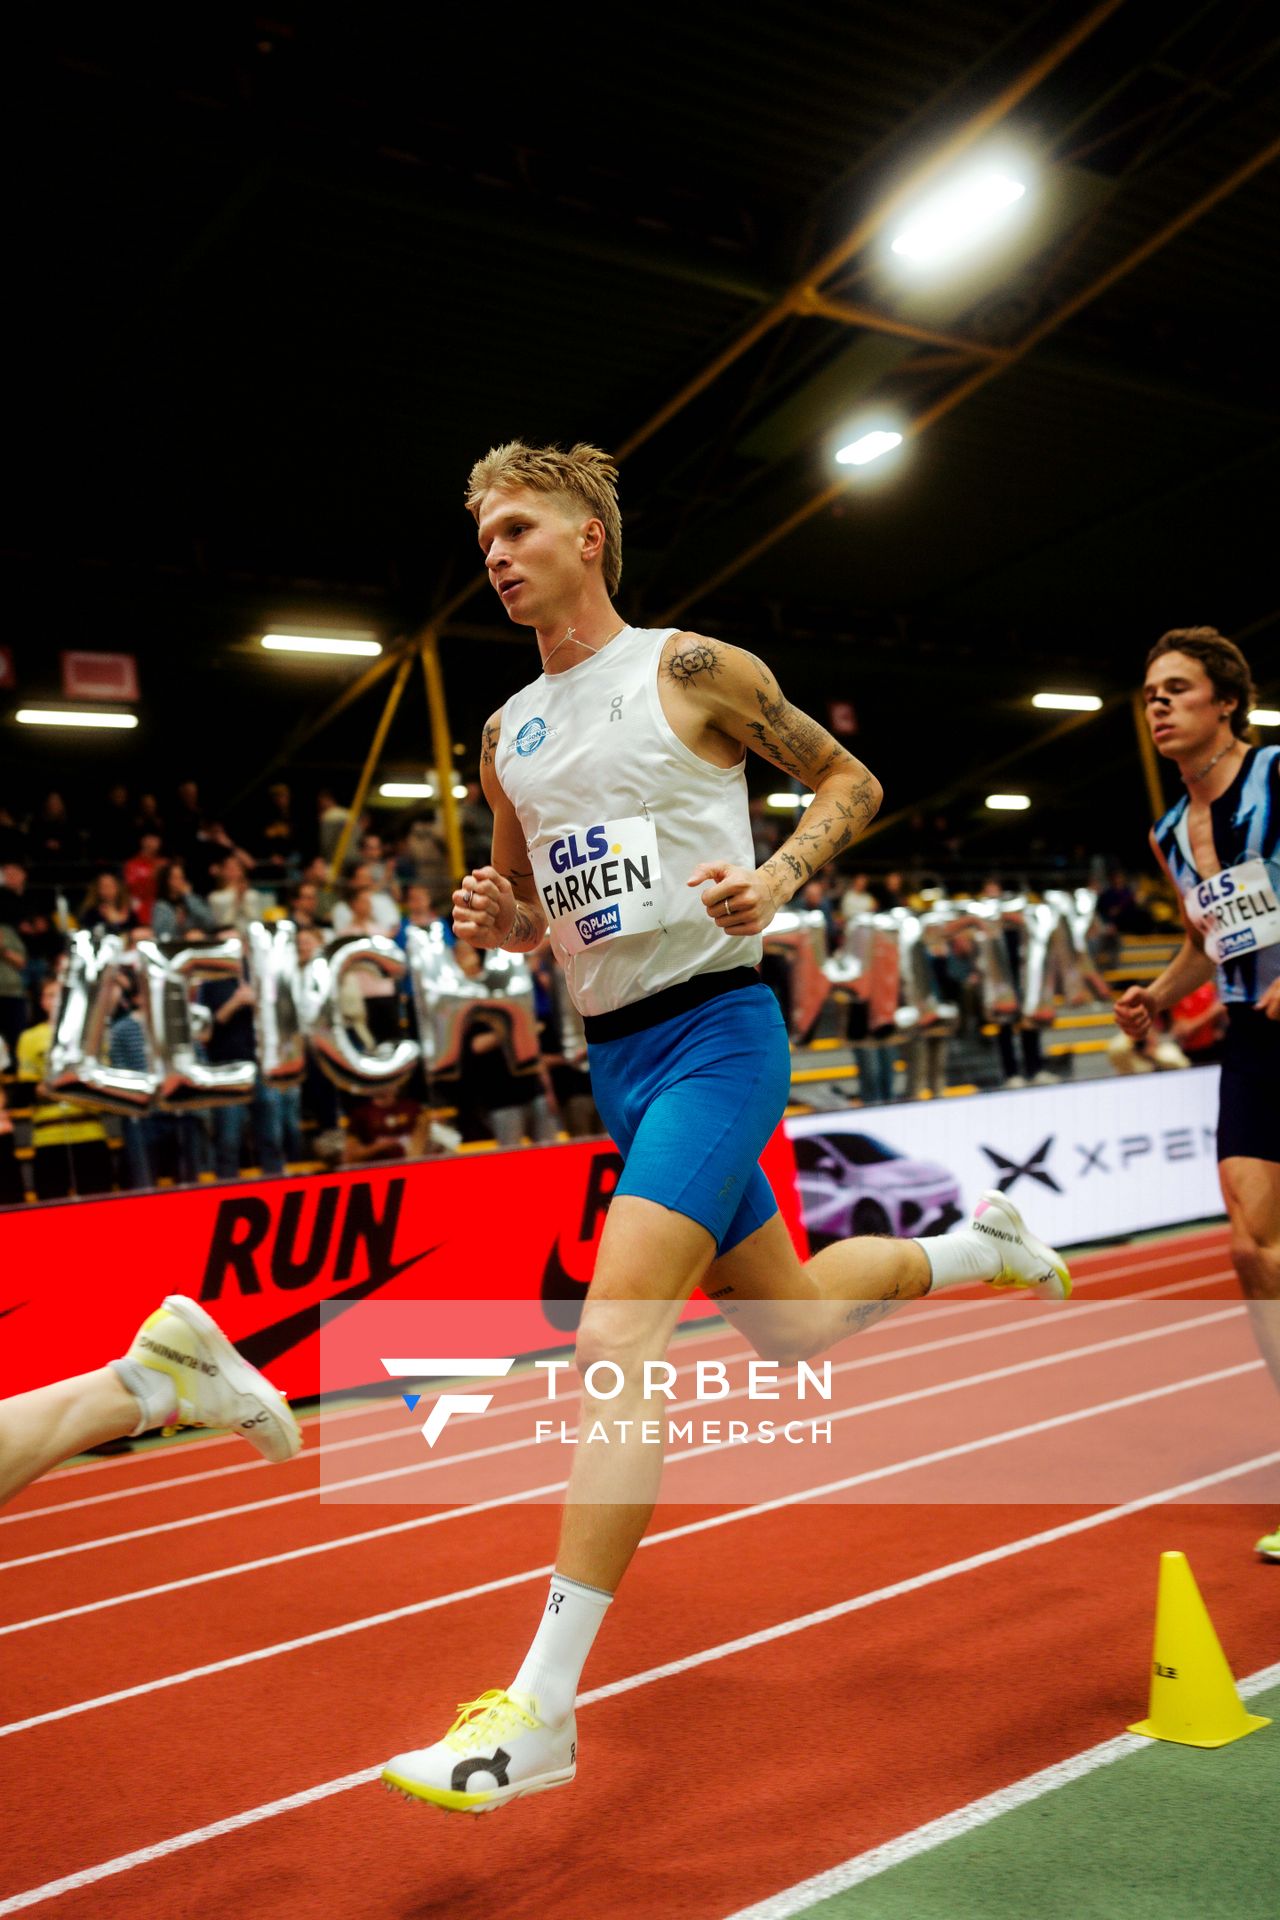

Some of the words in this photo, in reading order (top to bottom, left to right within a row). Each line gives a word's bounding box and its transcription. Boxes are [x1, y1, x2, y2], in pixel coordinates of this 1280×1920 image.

[542, 854, 652, 920] FARKEN
[1201, 890, 1277, 931] RTELL
[590, 910, 618, 931] PLAN
[199, 1177, 406, 1303] RUN
